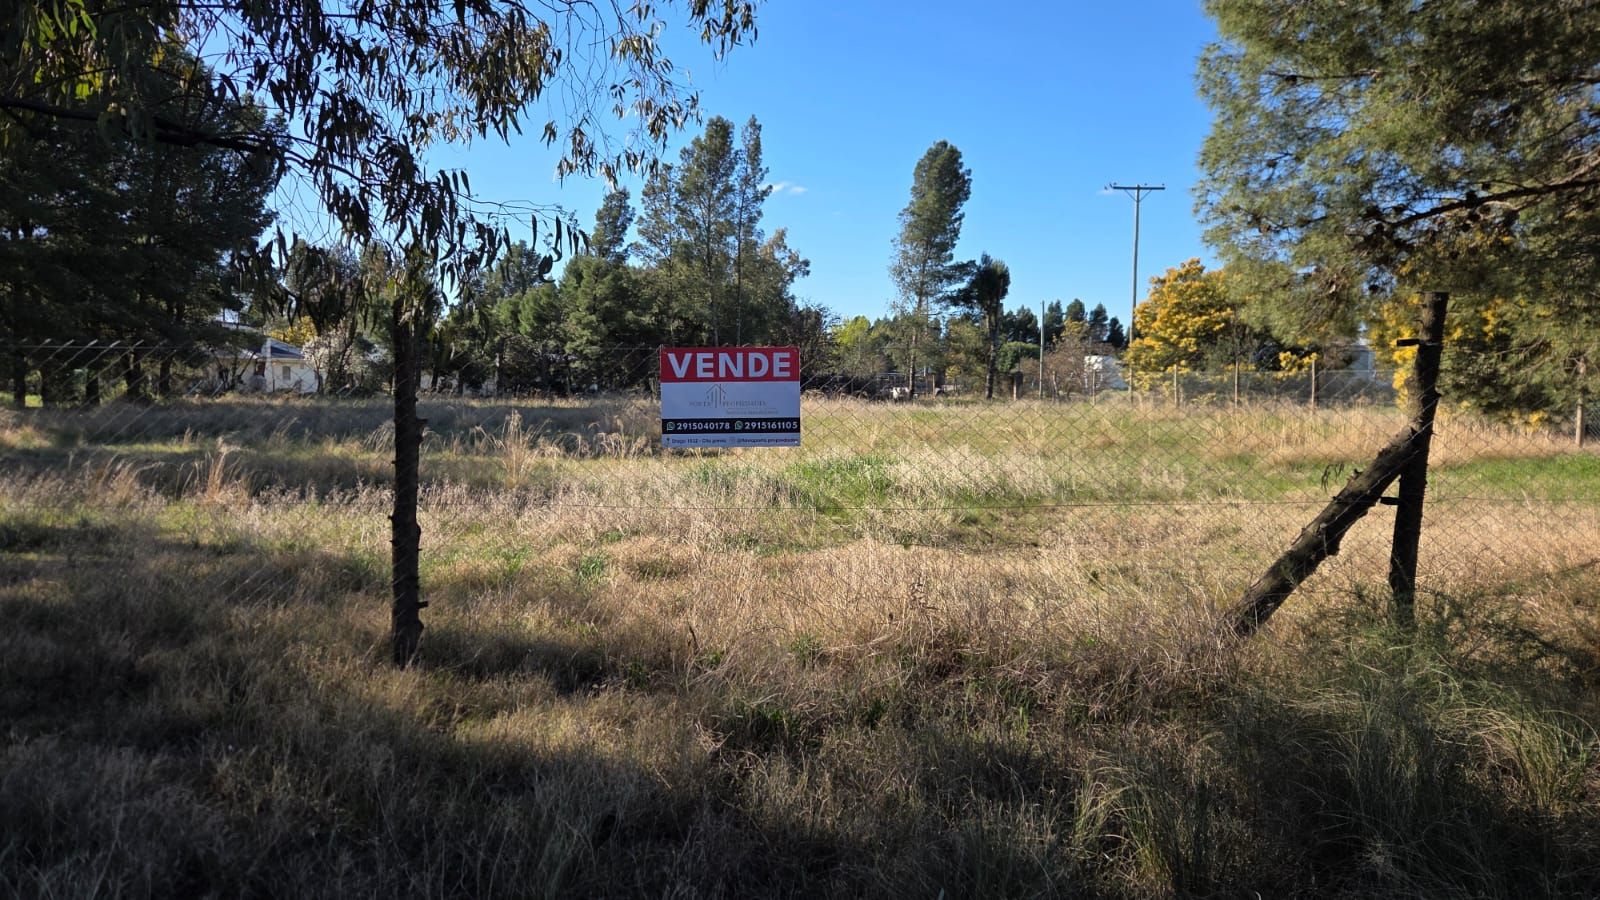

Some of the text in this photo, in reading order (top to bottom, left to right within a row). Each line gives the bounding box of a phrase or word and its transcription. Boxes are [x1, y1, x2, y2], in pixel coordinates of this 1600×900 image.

[668, 352, 791, 378] VENDE
[676, 421, 798, 430] 2915040178 2915161105
